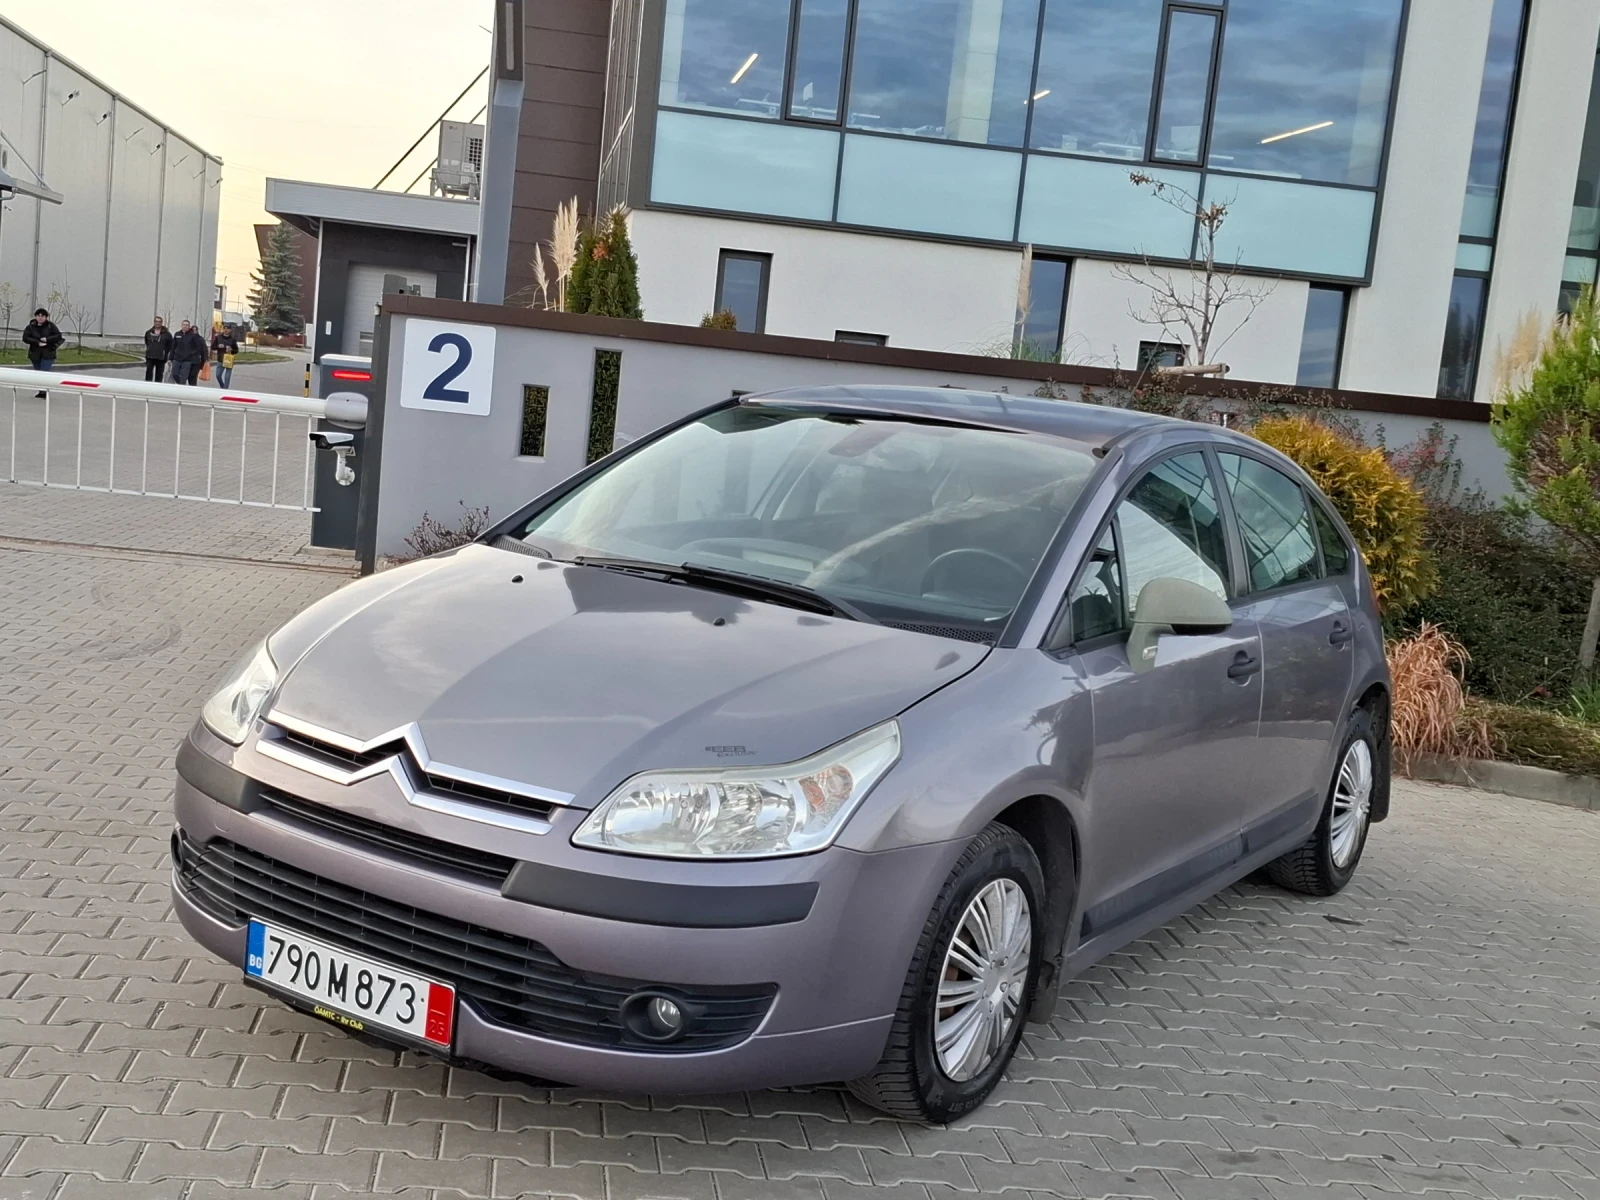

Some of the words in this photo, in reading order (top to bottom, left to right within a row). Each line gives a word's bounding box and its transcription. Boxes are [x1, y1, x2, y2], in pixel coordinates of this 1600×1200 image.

[423, 332, 473, 404] 2
[249, 953, 263, 970] BG
[268, 935, 321, 991] 790
[328, 957, 349, 1003] M
[355, 969, 416, 1025] 873
[350, 1019, 364, 1031] Club
